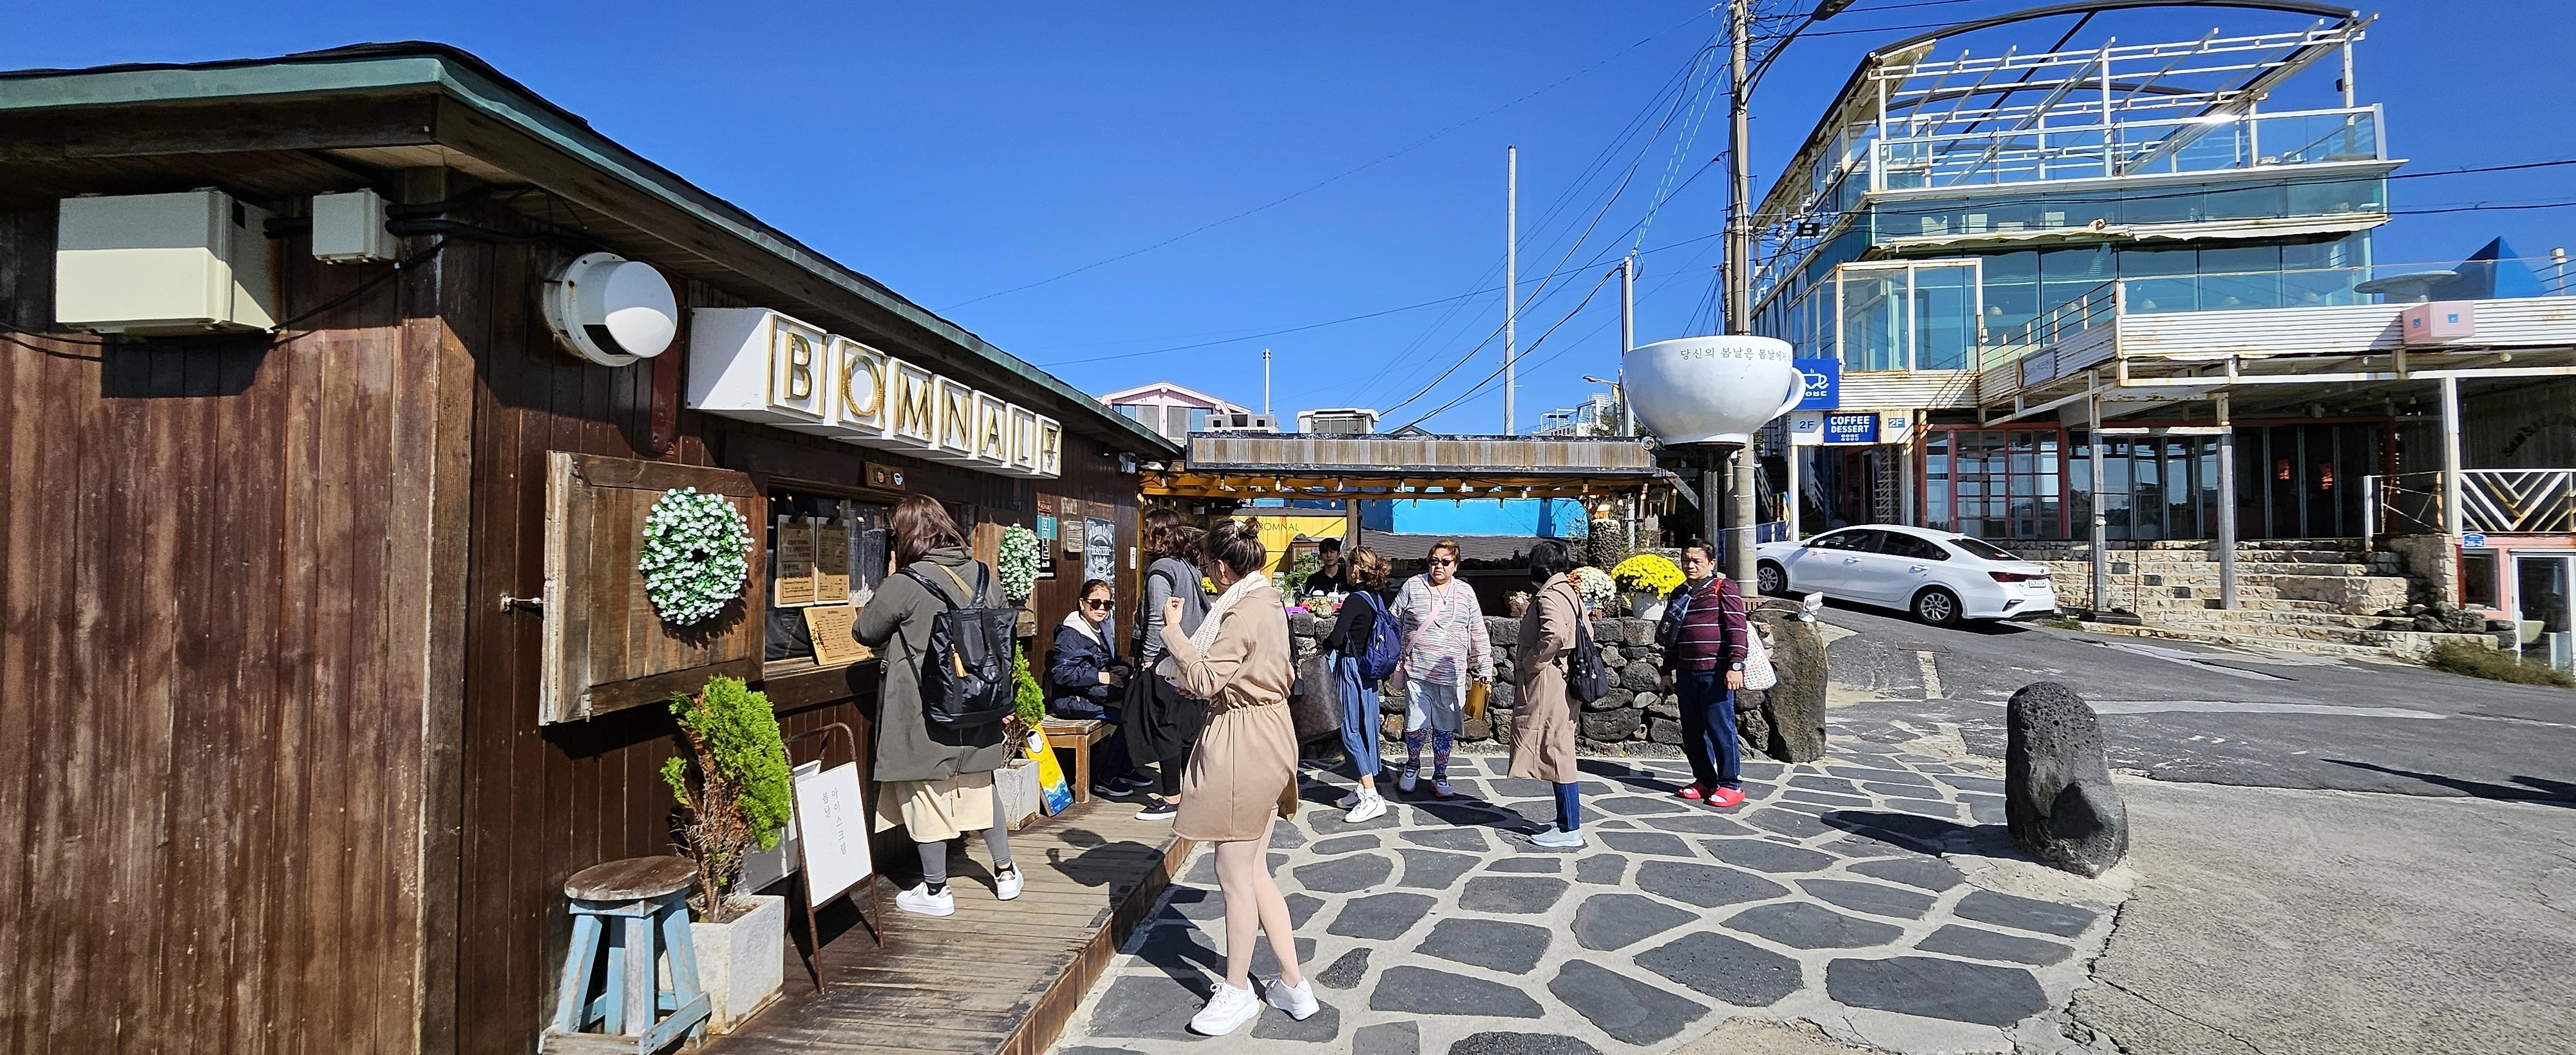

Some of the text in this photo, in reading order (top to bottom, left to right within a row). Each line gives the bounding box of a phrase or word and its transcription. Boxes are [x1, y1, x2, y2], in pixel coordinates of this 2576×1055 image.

[1680, 348, 1714, 360] 당신의
[1720, 347, 1754, 361] 봄날은
[784, 332, 1028, 462] BOMNAL
[1799, 421, 1815, 429] 2F
[1830, 415, 1870, 425] COFFEE
[1889, 419, 1904, 427] 2F
[1831, 425, 1870, 433] DESSERT
[822, 791, 831, 818] 봄날
[831, 787, 847, 855] 아이스크림
